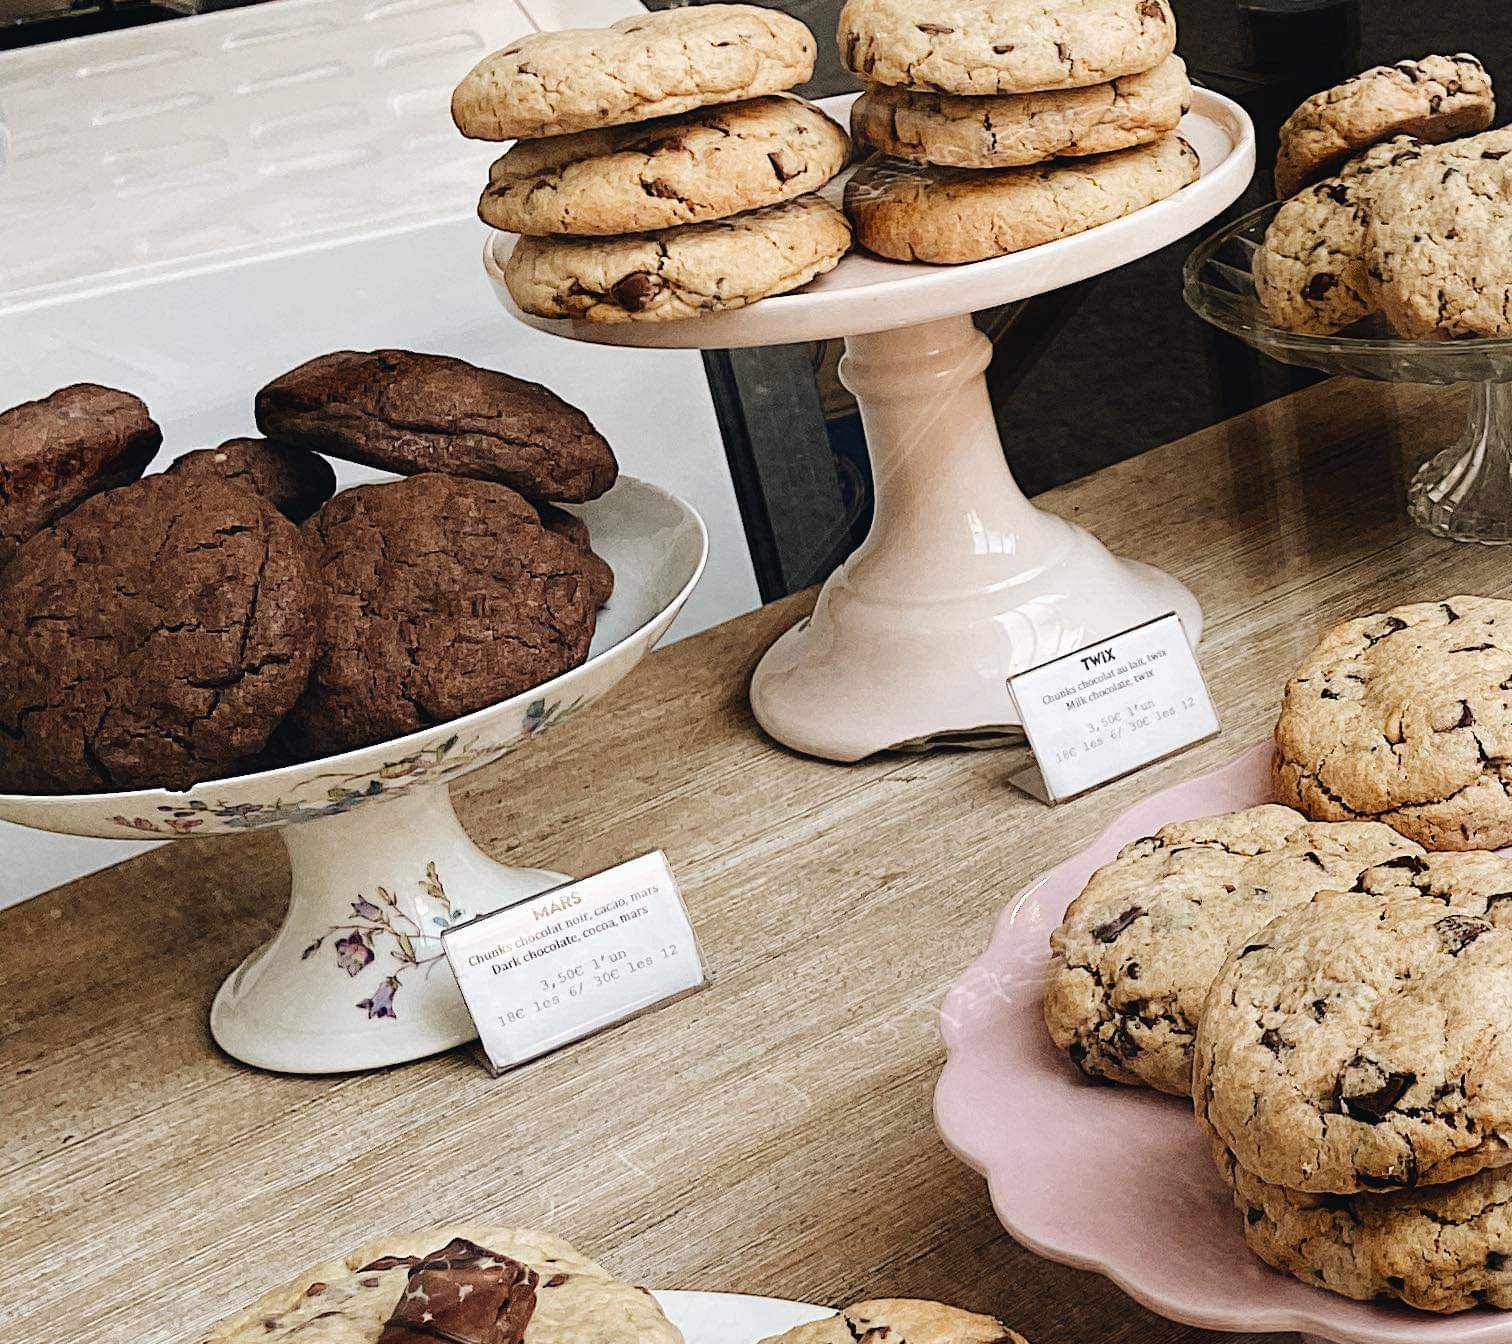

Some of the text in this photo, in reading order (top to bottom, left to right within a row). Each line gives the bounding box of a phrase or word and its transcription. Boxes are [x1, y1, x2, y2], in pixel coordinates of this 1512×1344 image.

[1077, 668, 1116, 692] chocolat
[1117, 662, 1130, 676] au
[1147, 648, 1168, 664] twix
[1080, 647, 1116, 671] TWIX
[1065, 695, 1088, 712] Milk
[1134, 668, 1155, 684] twix
[1156, 706, 1176, 721] les
[1181, 696, 1196, 711] 12
[468, 942, 513, 968] Chunks
[514, 921, 564, 951] chocolat
[629, 884, 660, 902] mars
[532, 892, 583, 922] MARS
[491, 956, 522, 977] Dark
[619, 905, 649, 924] mars
[498, 1007, 526, 1027] 18€
[533, 994, 561, 1013] les
[594, 967, 621, 987] 30€
[628, 955, 655, 974] les
[661, 944, 679, 961] 12
[540, 964, 585, 992] 3,50€
